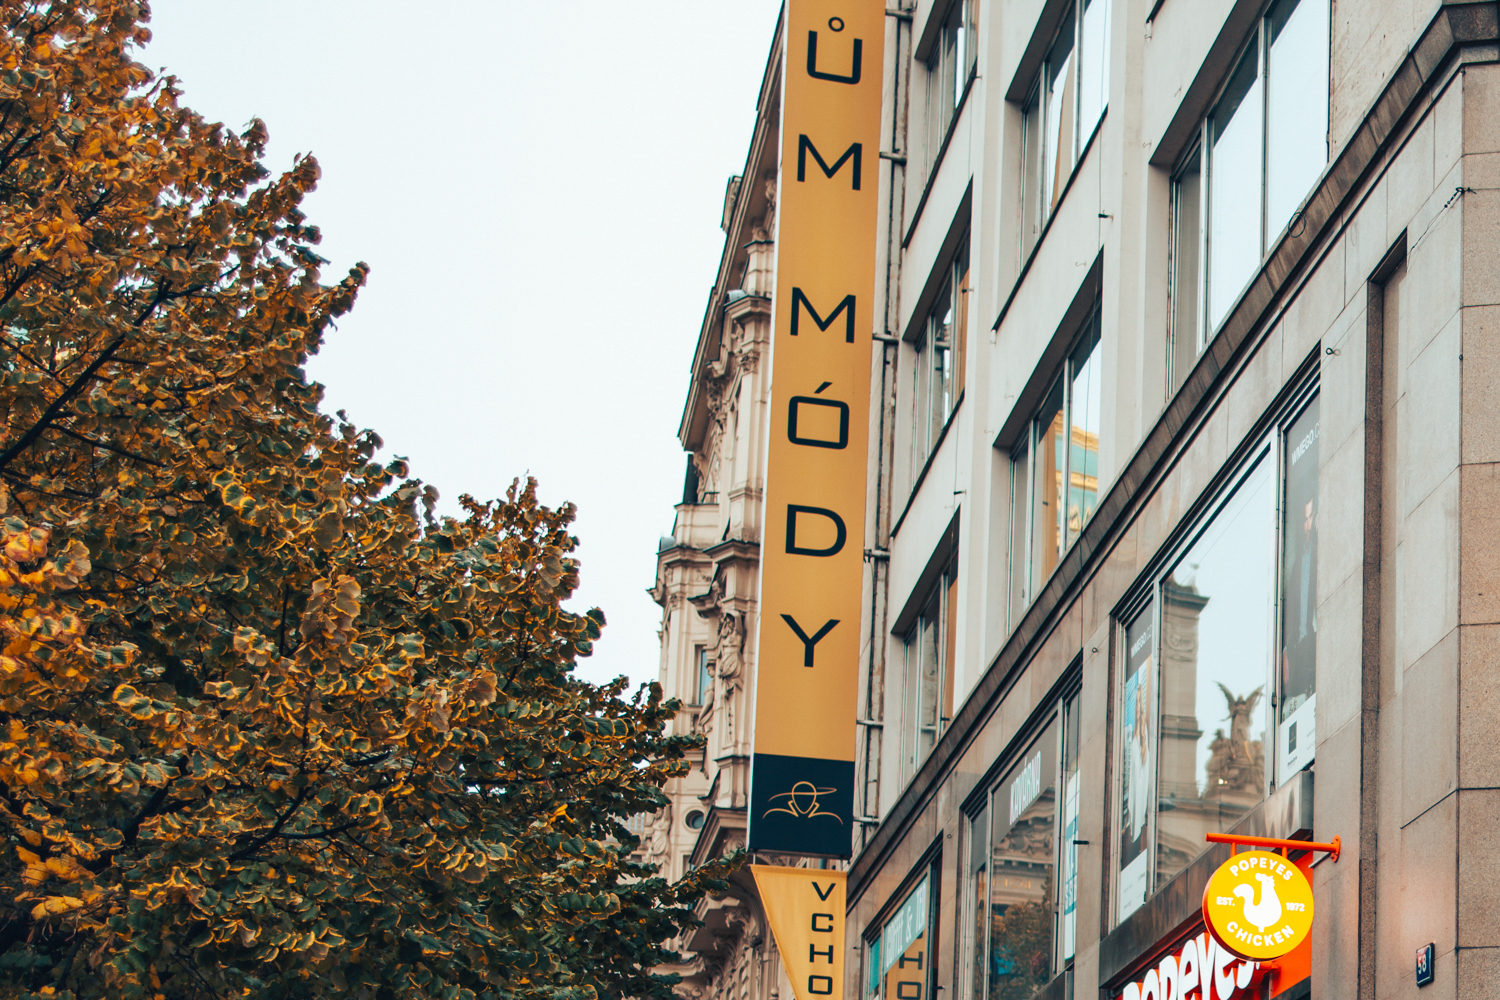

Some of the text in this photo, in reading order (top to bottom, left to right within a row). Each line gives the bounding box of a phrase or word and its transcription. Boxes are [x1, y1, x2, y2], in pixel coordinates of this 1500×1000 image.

[1292, 422, 1320, 466] WMEGO.C
[1229, 857, 1293, 881] POPEYES
[1216, 896, 1305, 912] EST. 1972
[1226, 921, 1294, 947] CHICKEN
